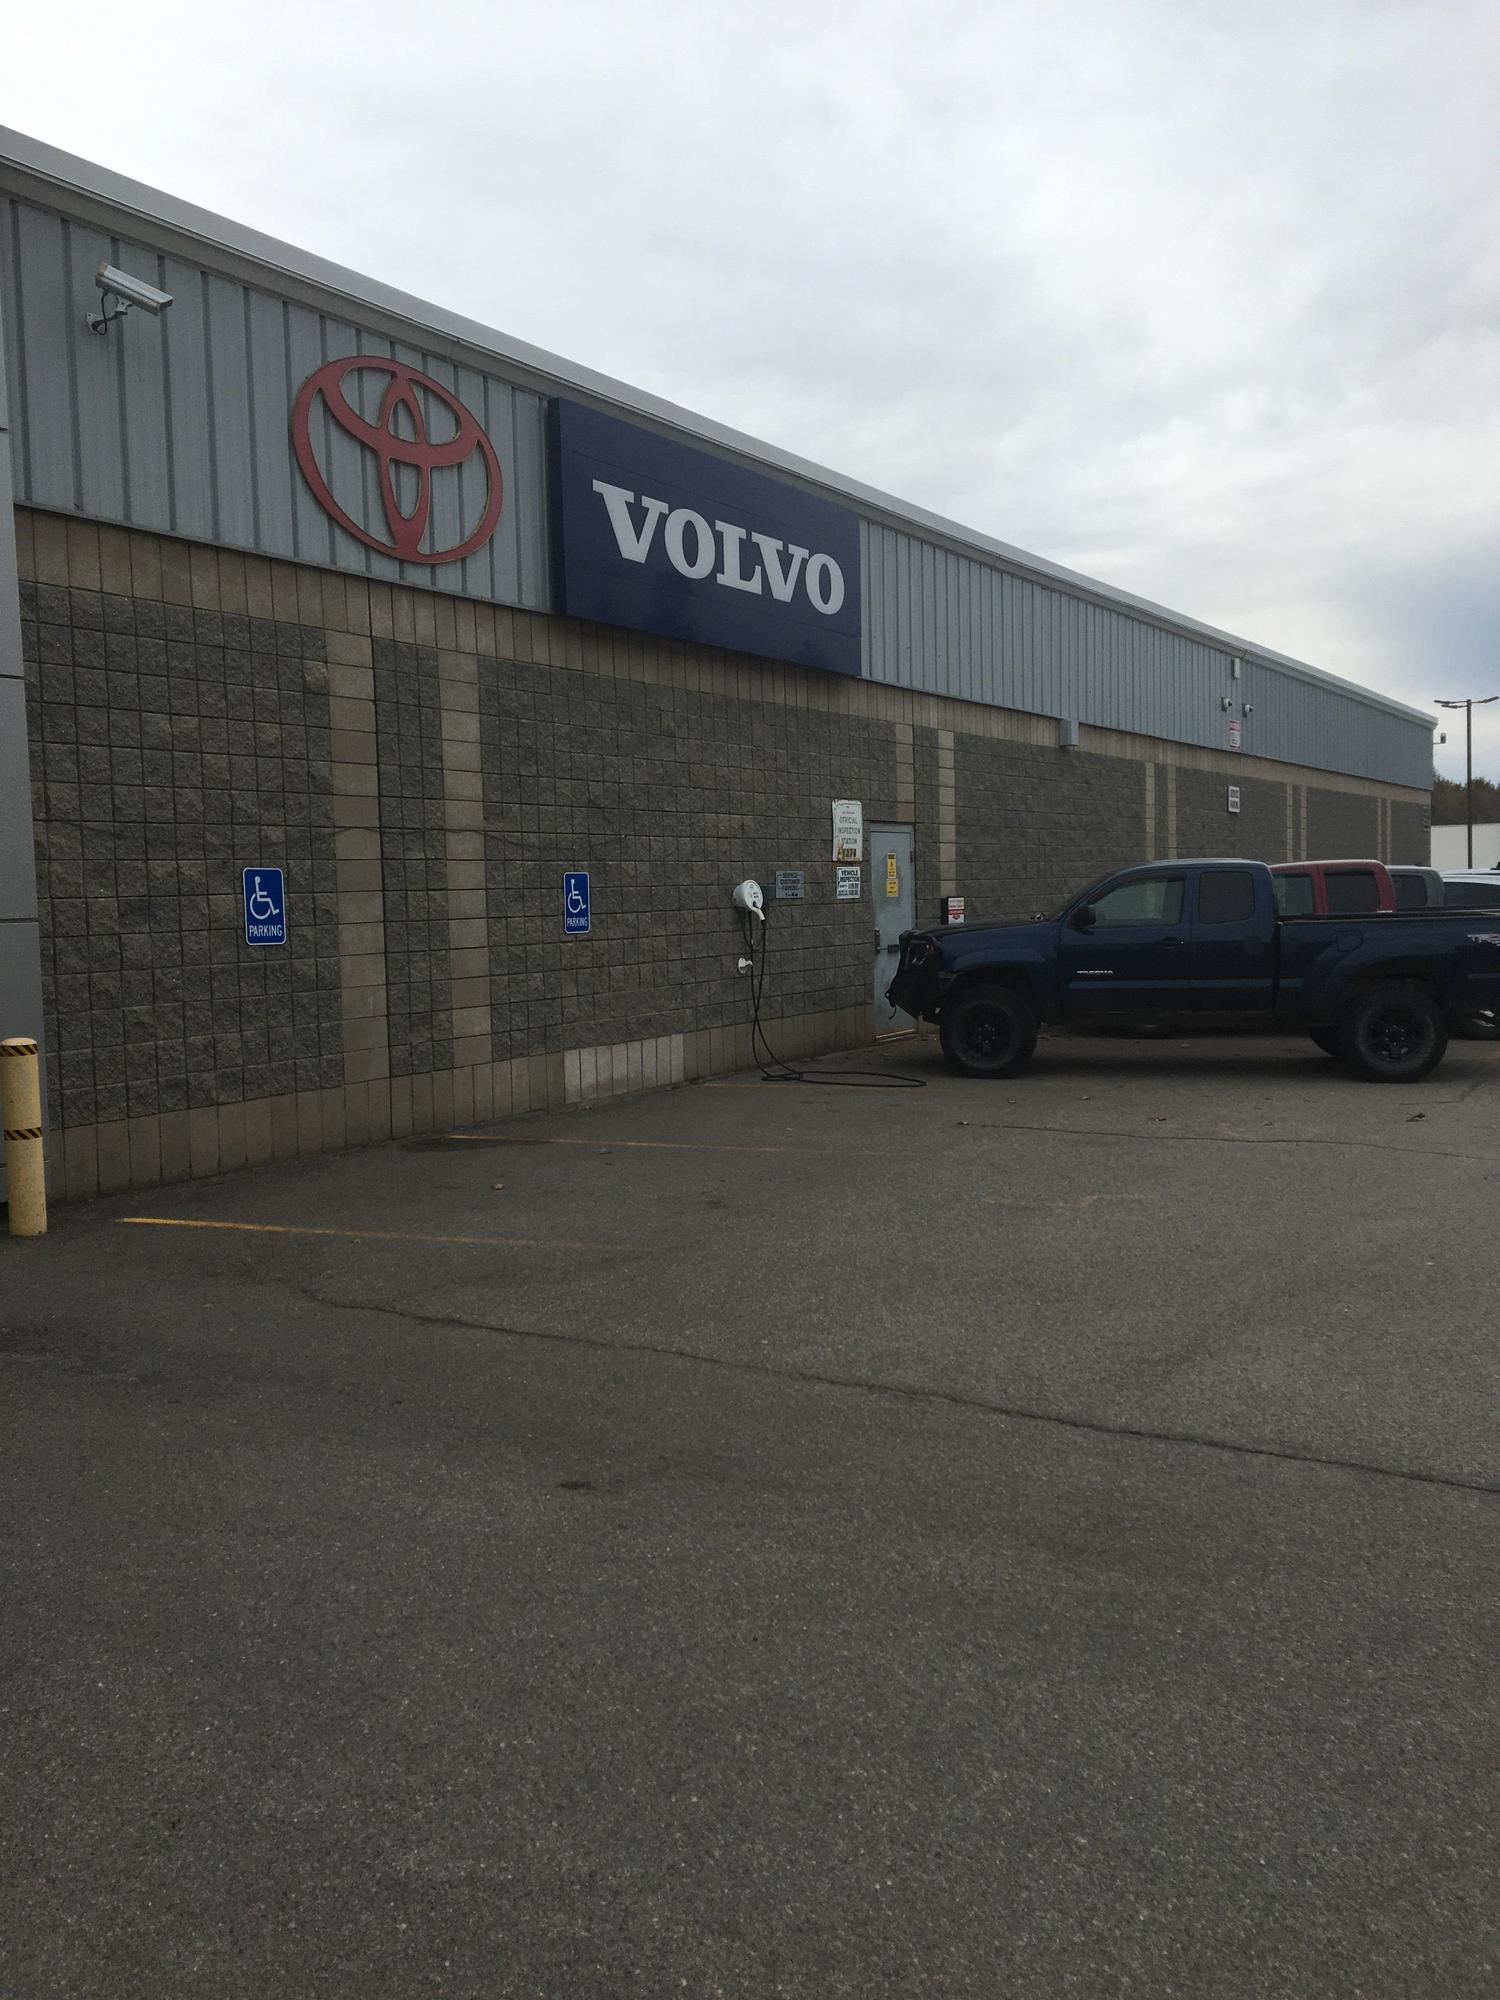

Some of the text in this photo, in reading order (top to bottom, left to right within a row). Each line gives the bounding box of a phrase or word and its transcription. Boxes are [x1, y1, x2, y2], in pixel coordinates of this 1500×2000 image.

[592, 479, 845, 615] VOLVO
[839, 816, 858, 825] OFFICIAL
[837, 827, 861, 835] INSPECTION
[841, 837, 858, 845] STATION
[567, 917, 588, 927] PARKING
[249, 924, 283, 937] PARKING
